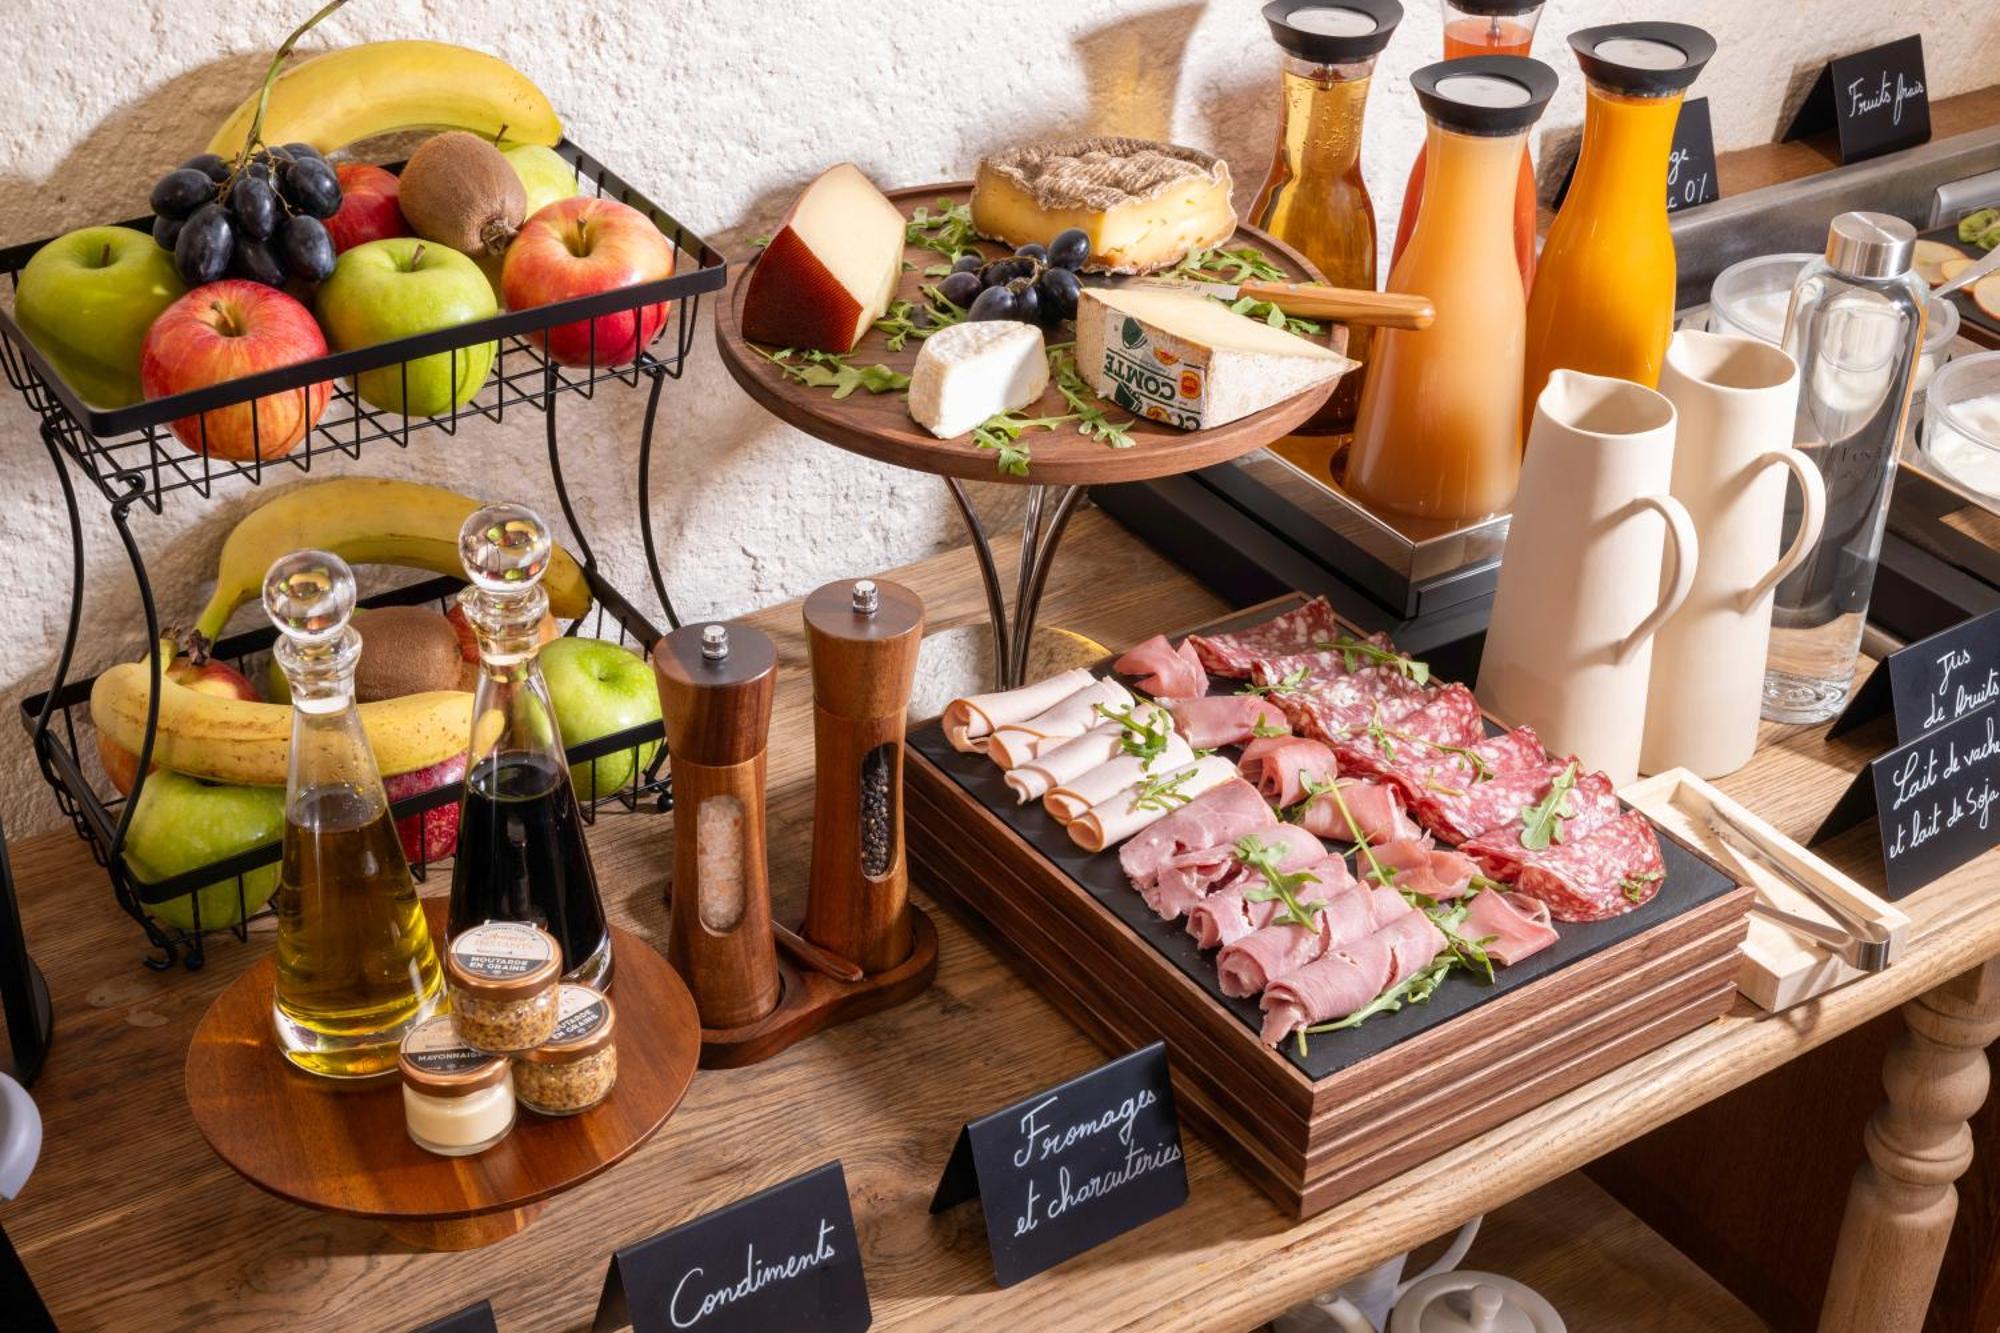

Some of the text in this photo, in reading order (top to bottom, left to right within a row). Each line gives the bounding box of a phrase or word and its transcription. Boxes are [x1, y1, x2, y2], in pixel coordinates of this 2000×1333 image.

[1848, 71, 1924, 126] Fruits frais
[1684, 172, 1709, 203] 0%
[1936, 649, 1971, 696] Jus
[1923, 692, 1946, 729] de
[1892, 716, 2000, 811] Lait de vache
[1889, 777, 2000, 858] et lait de Soja
[471, 956, 529, 966] MOUTARDE
[555, 1009, 593, 1031] OUTARDE
[1013, 1089, 1157, 1167] Fromages
[1014, 1180, 1041, 1238] et
[670, 1218, 835, 1328] Condiments
